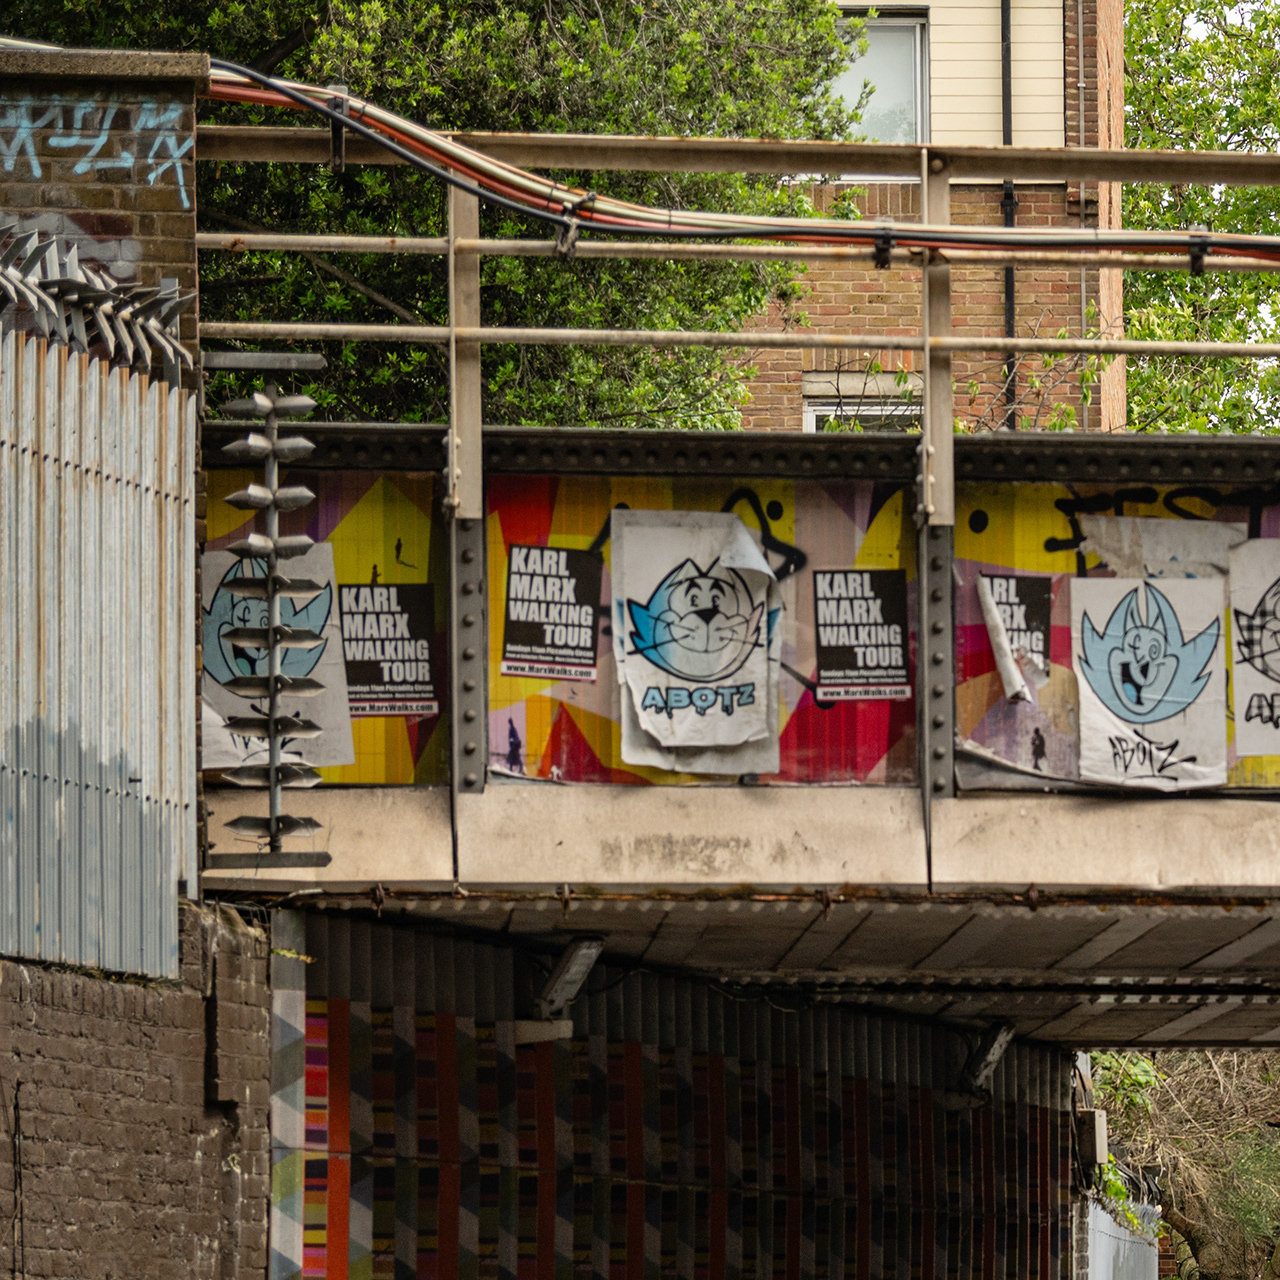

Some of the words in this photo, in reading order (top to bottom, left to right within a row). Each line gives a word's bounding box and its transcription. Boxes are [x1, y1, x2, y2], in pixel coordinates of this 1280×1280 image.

[511, 547, 570, 576] KARL
[510, 573, 577, 604] MARX
[816, 572, 875, 598] KARL
[342, 586, 401, 612] KARL
[817, 598, 884, 624] MARX
[343, 613, 410, 639] MARX
[509, 600, 594, 627] WALKING
[998, 604, 1027, 630] RX
[543, 624, 593, 648] TOUR
[819, 624, 902, 647] WALKING
[344, 639, 429, 661] WALKING
[854, 646, 903, 667] TOUR
[380, 661, 430, 682] TOUR
[506, 664, 592, 678] www.MarxWalks.com
[642, 683, 755, 718] ABOTZ
[1108, 729, 1197, 774] ABOTZ
